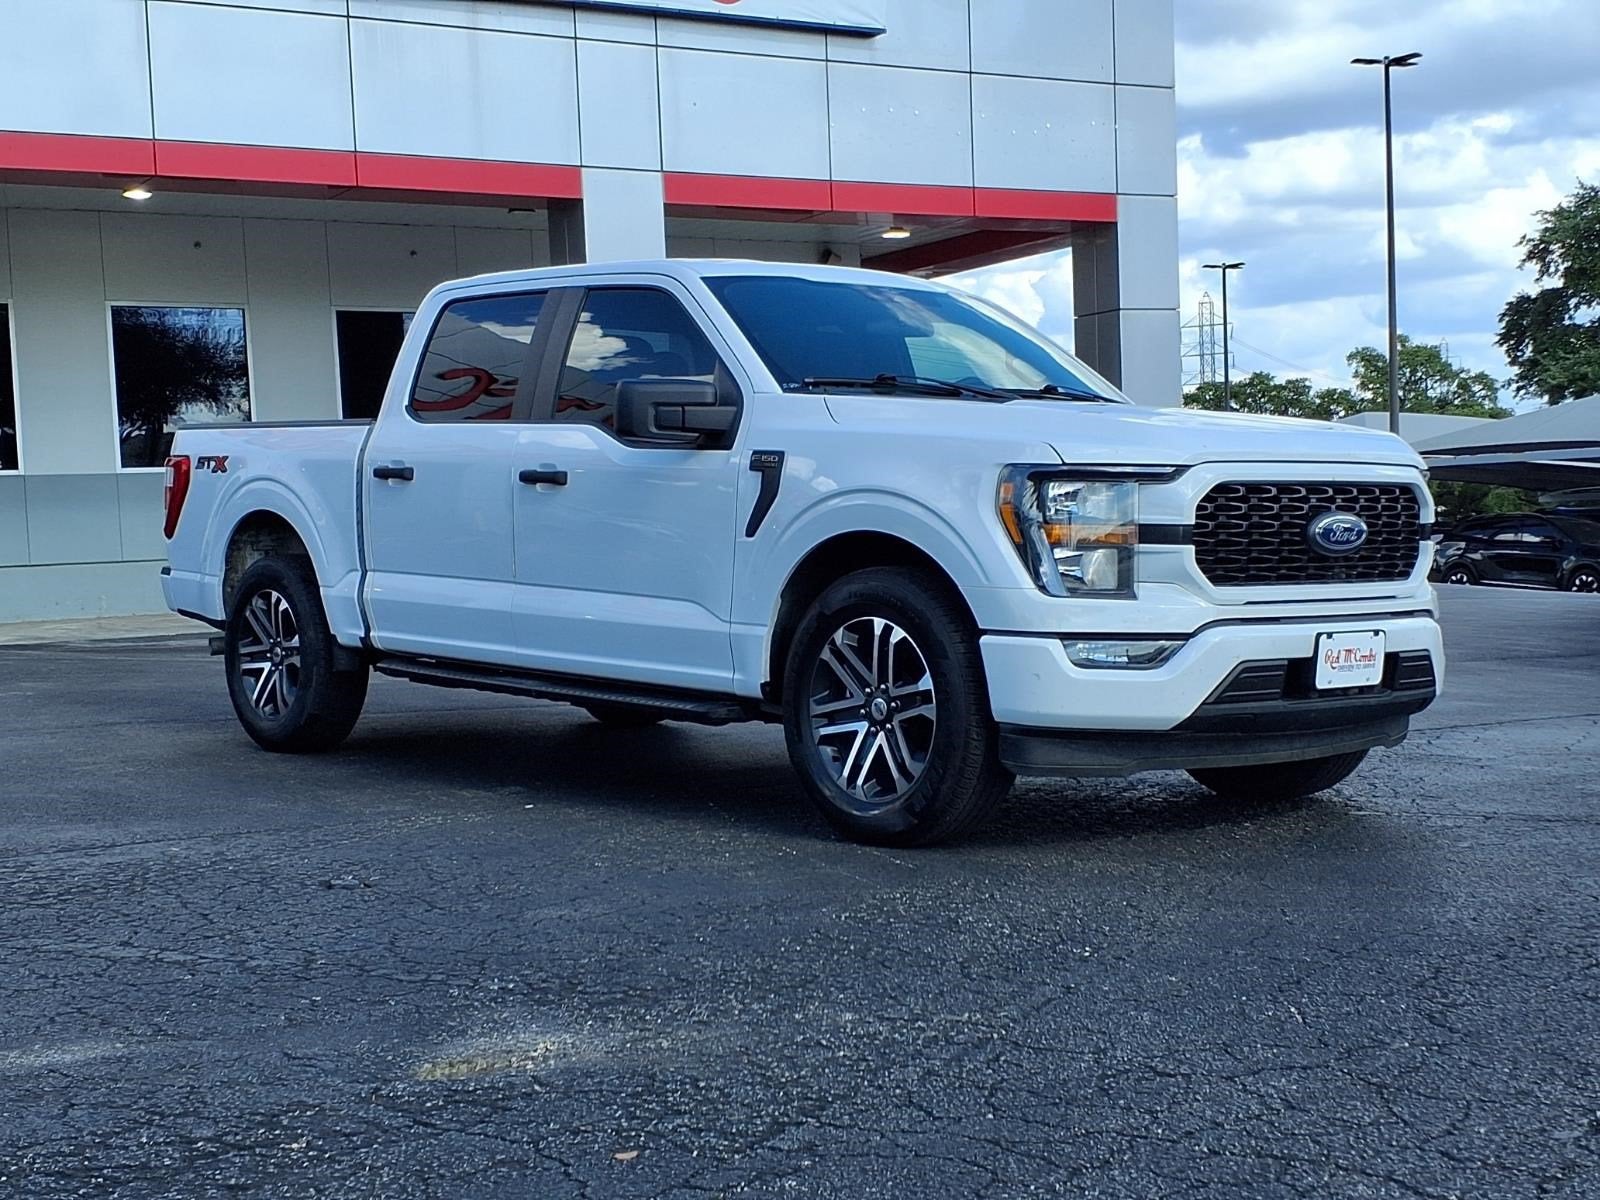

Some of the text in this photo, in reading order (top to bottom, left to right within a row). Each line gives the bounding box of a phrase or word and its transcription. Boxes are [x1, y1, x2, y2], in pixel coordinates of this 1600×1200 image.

[195, 455, 229, 473] STX
[1330, 523, 1358, 541] Ford
[1324, 648, 1341, 670] Red
